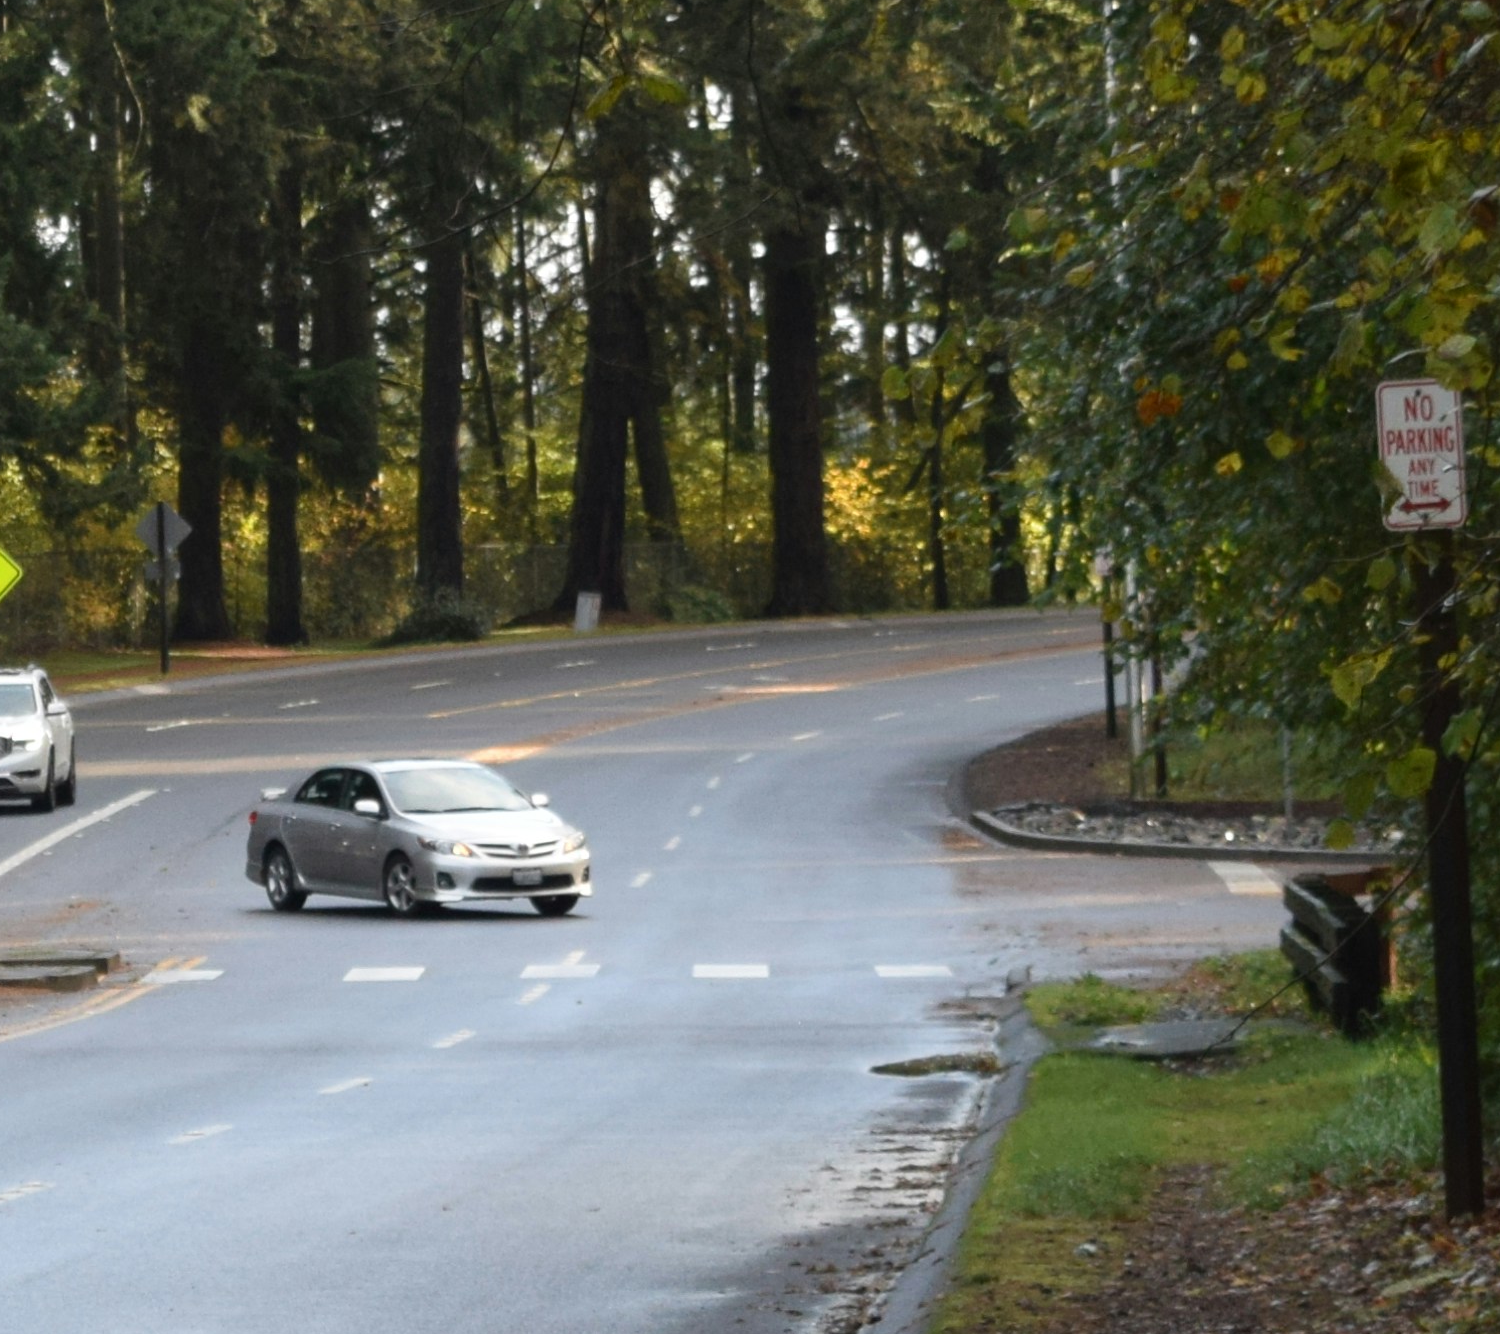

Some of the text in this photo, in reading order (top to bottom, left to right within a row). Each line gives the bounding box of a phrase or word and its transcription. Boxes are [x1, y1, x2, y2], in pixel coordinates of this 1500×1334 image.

[1404, 395, 1434, 423] NO
[1386, 426, 1455, 455] PARKING
[1408, 459, 1436, 476] ANY
[1408, 479, 1439, 499] TIME
